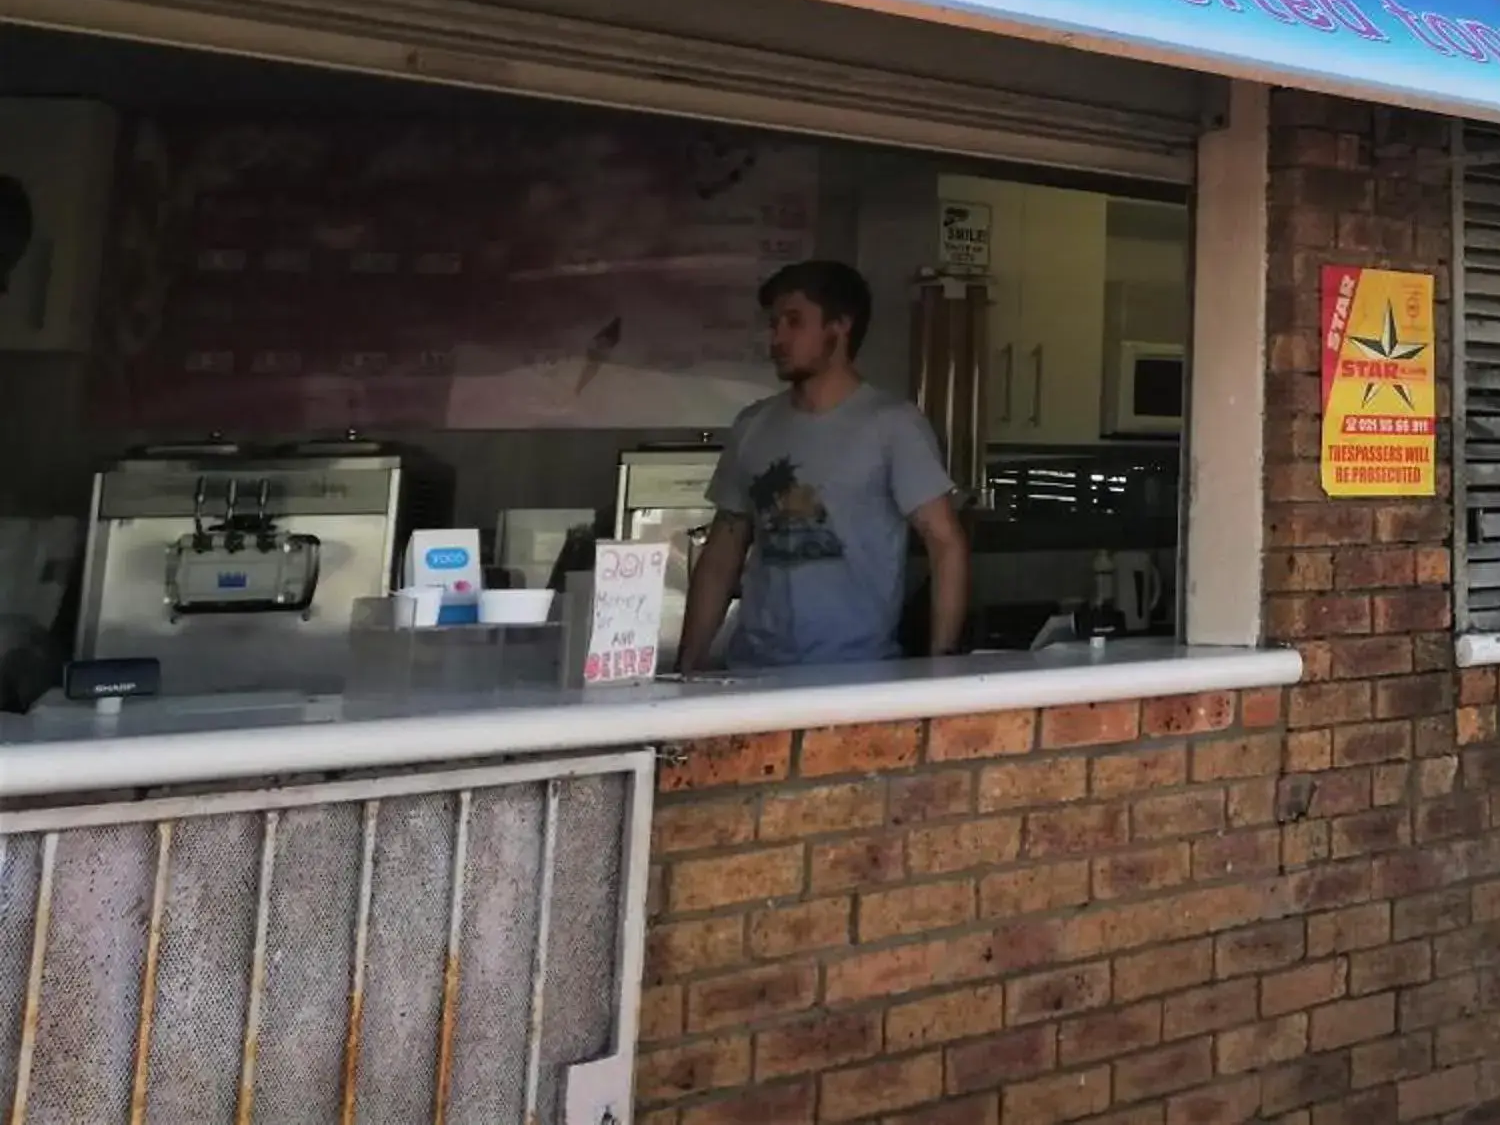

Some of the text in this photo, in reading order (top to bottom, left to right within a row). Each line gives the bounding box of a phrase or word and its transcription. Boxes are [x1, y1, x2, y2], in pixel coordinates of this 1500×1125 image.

[1327, 275, 1356, 352] STAR
[1341, 360, 1399, 379] STAR
[1328, 444, 1430, 463] TRESPASSERS WILL
[1335, 466, 1421, 484] BE PROSECUTED
[611, 632, 635, 646] AND
[584, 646, 654, 680] BEERS
[95, 682, 136, 693] SHARP
